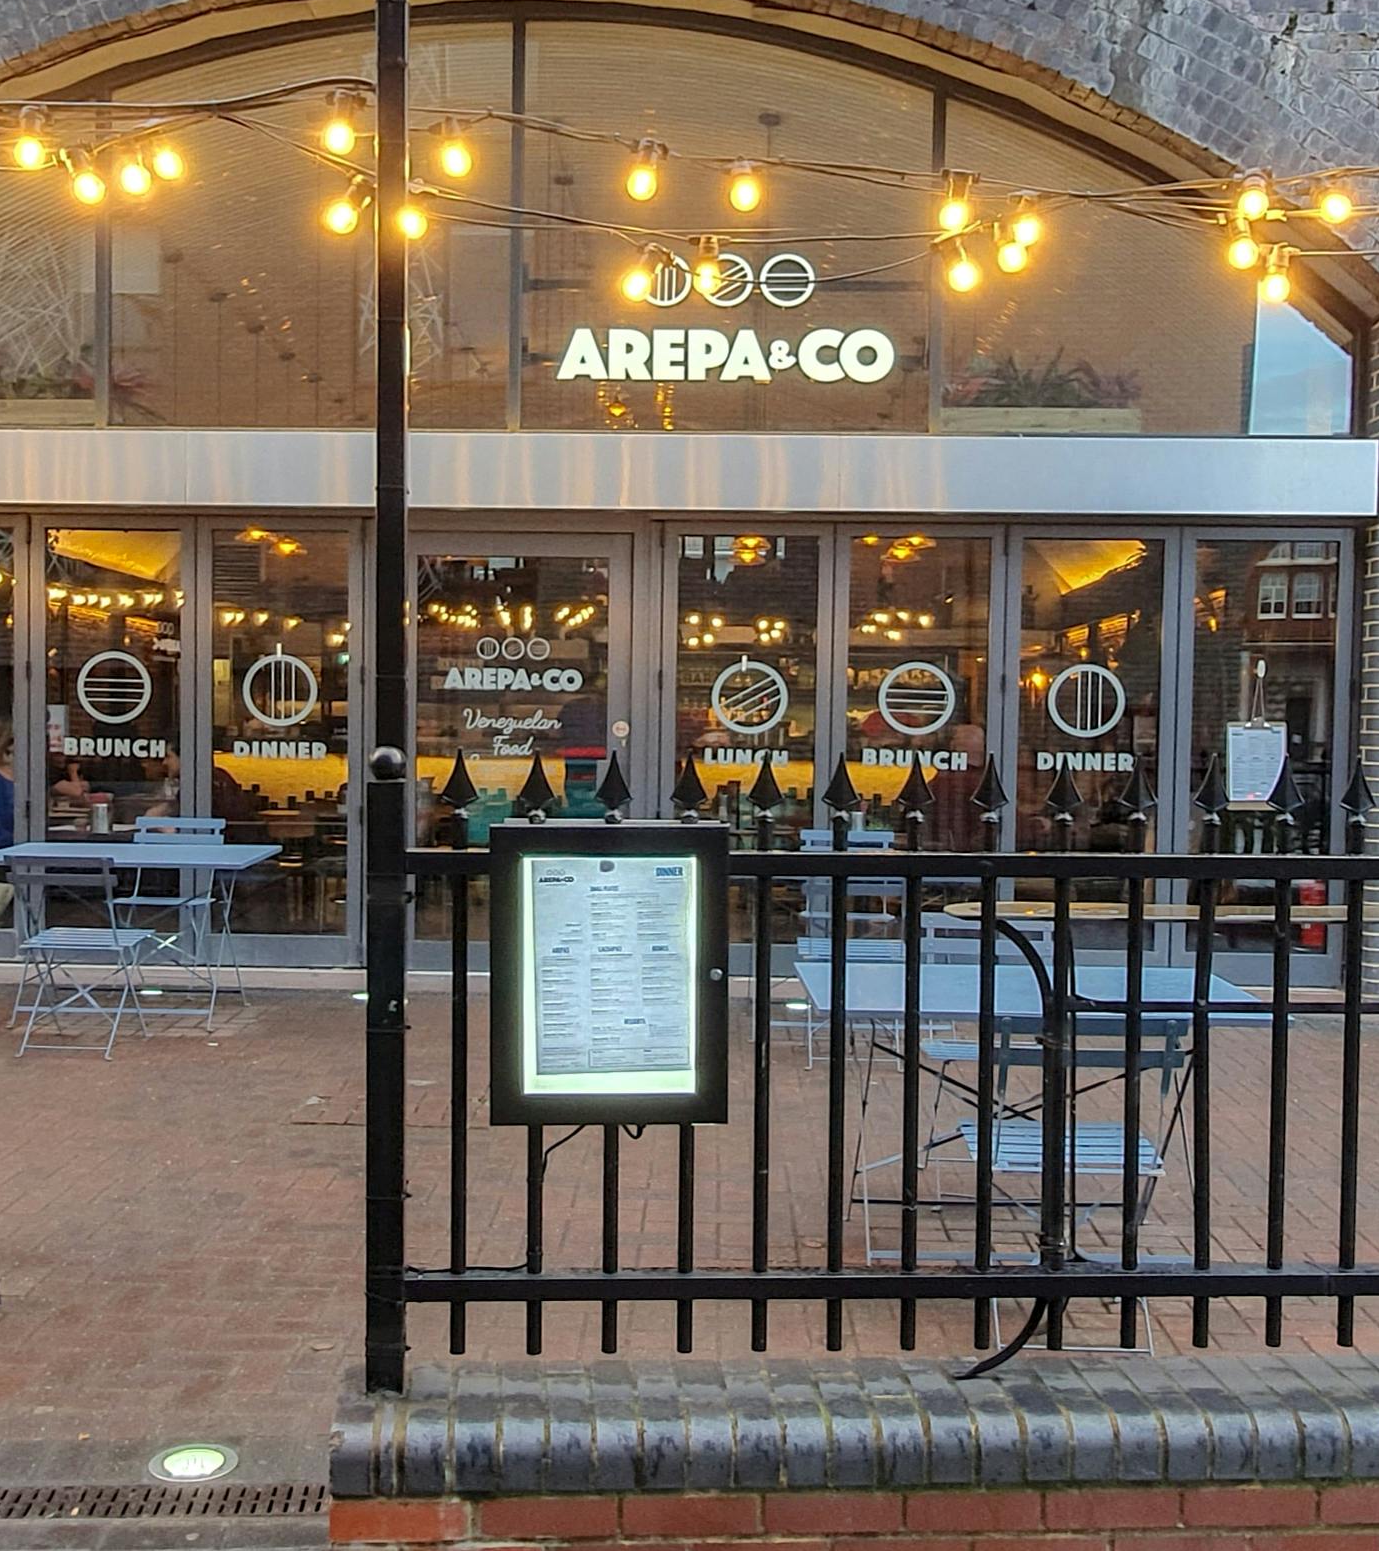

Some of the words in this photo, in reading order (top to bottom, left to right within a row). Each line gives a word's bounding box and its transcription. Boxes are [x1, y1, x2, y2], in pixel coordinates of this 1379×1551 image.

[556, 328, 896, 383] AREPA&CO
[443, 667, 583, 692] AREPA&CO
[463, 708, 563, 734] Venezuelan
[63, 737, 167, 759] BRUNCH
[233, 741, 329, 760] DINNER
[492, 735, 535, 756] Food
[861, 747, 968, 771] BRUNCH
